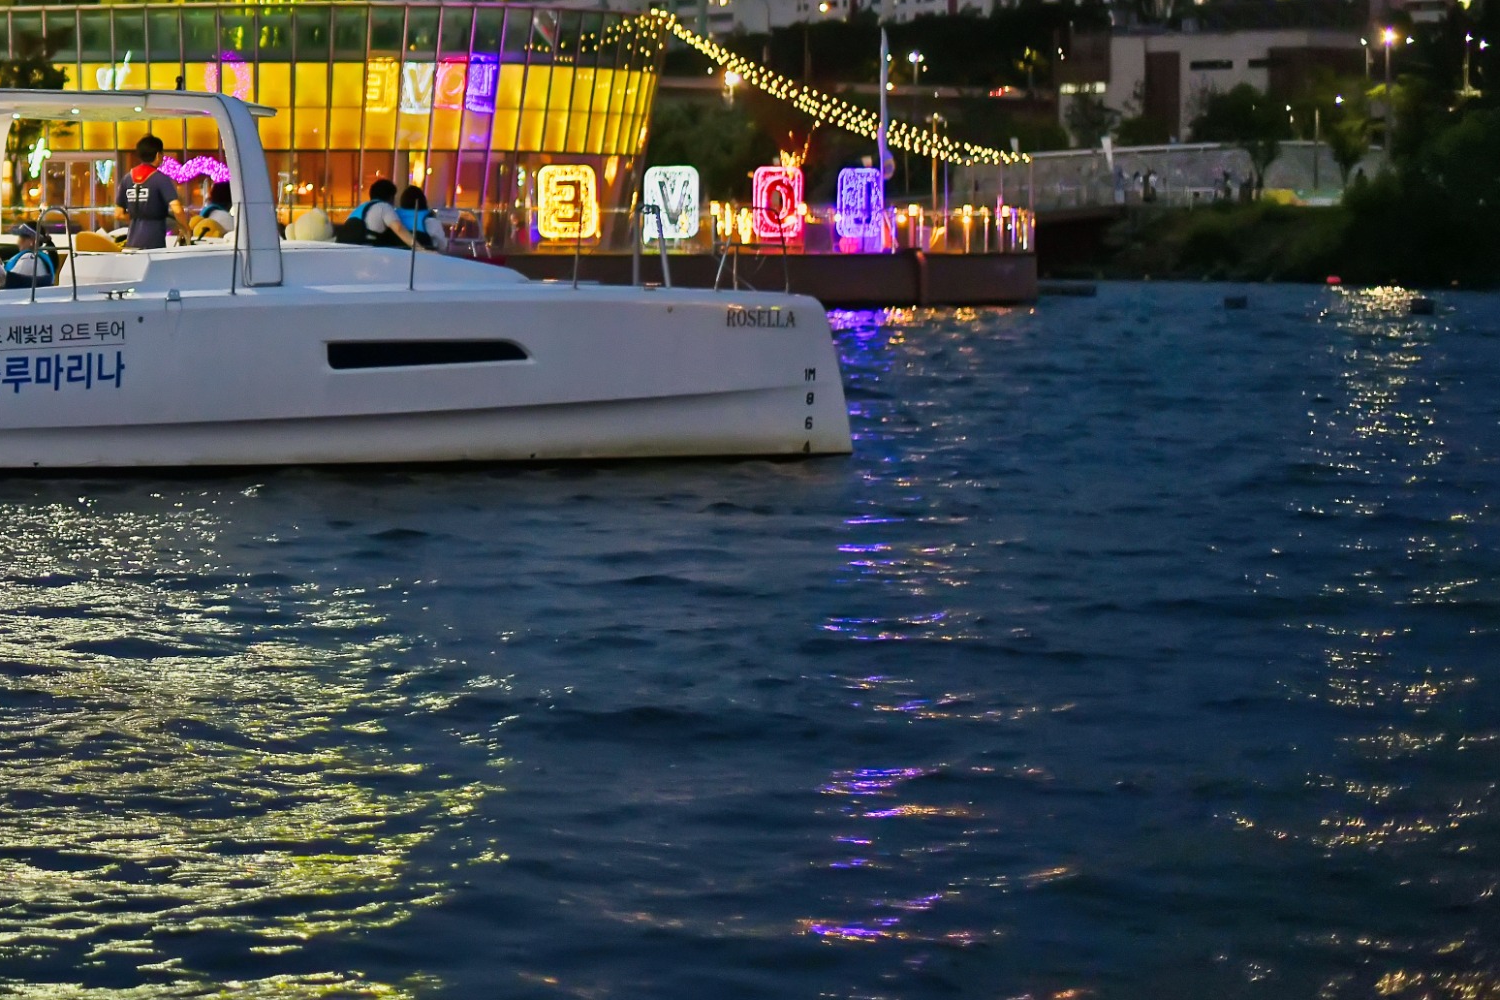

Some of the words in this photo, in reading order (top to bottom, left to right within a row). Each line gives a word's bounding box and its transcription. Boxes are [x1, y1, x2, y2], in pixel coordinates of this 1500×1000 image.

[726, 309, 796, 328] ROSELLA
[7, 324, 53, 344] 세빛섬
[59, 323, 91, 341] 요트
[94, 320, 125, 341] 투어
[804, 368, 816, 381] 1M
[806, 392, 814, 405] 8
[804, 416, 813, 430] 6
